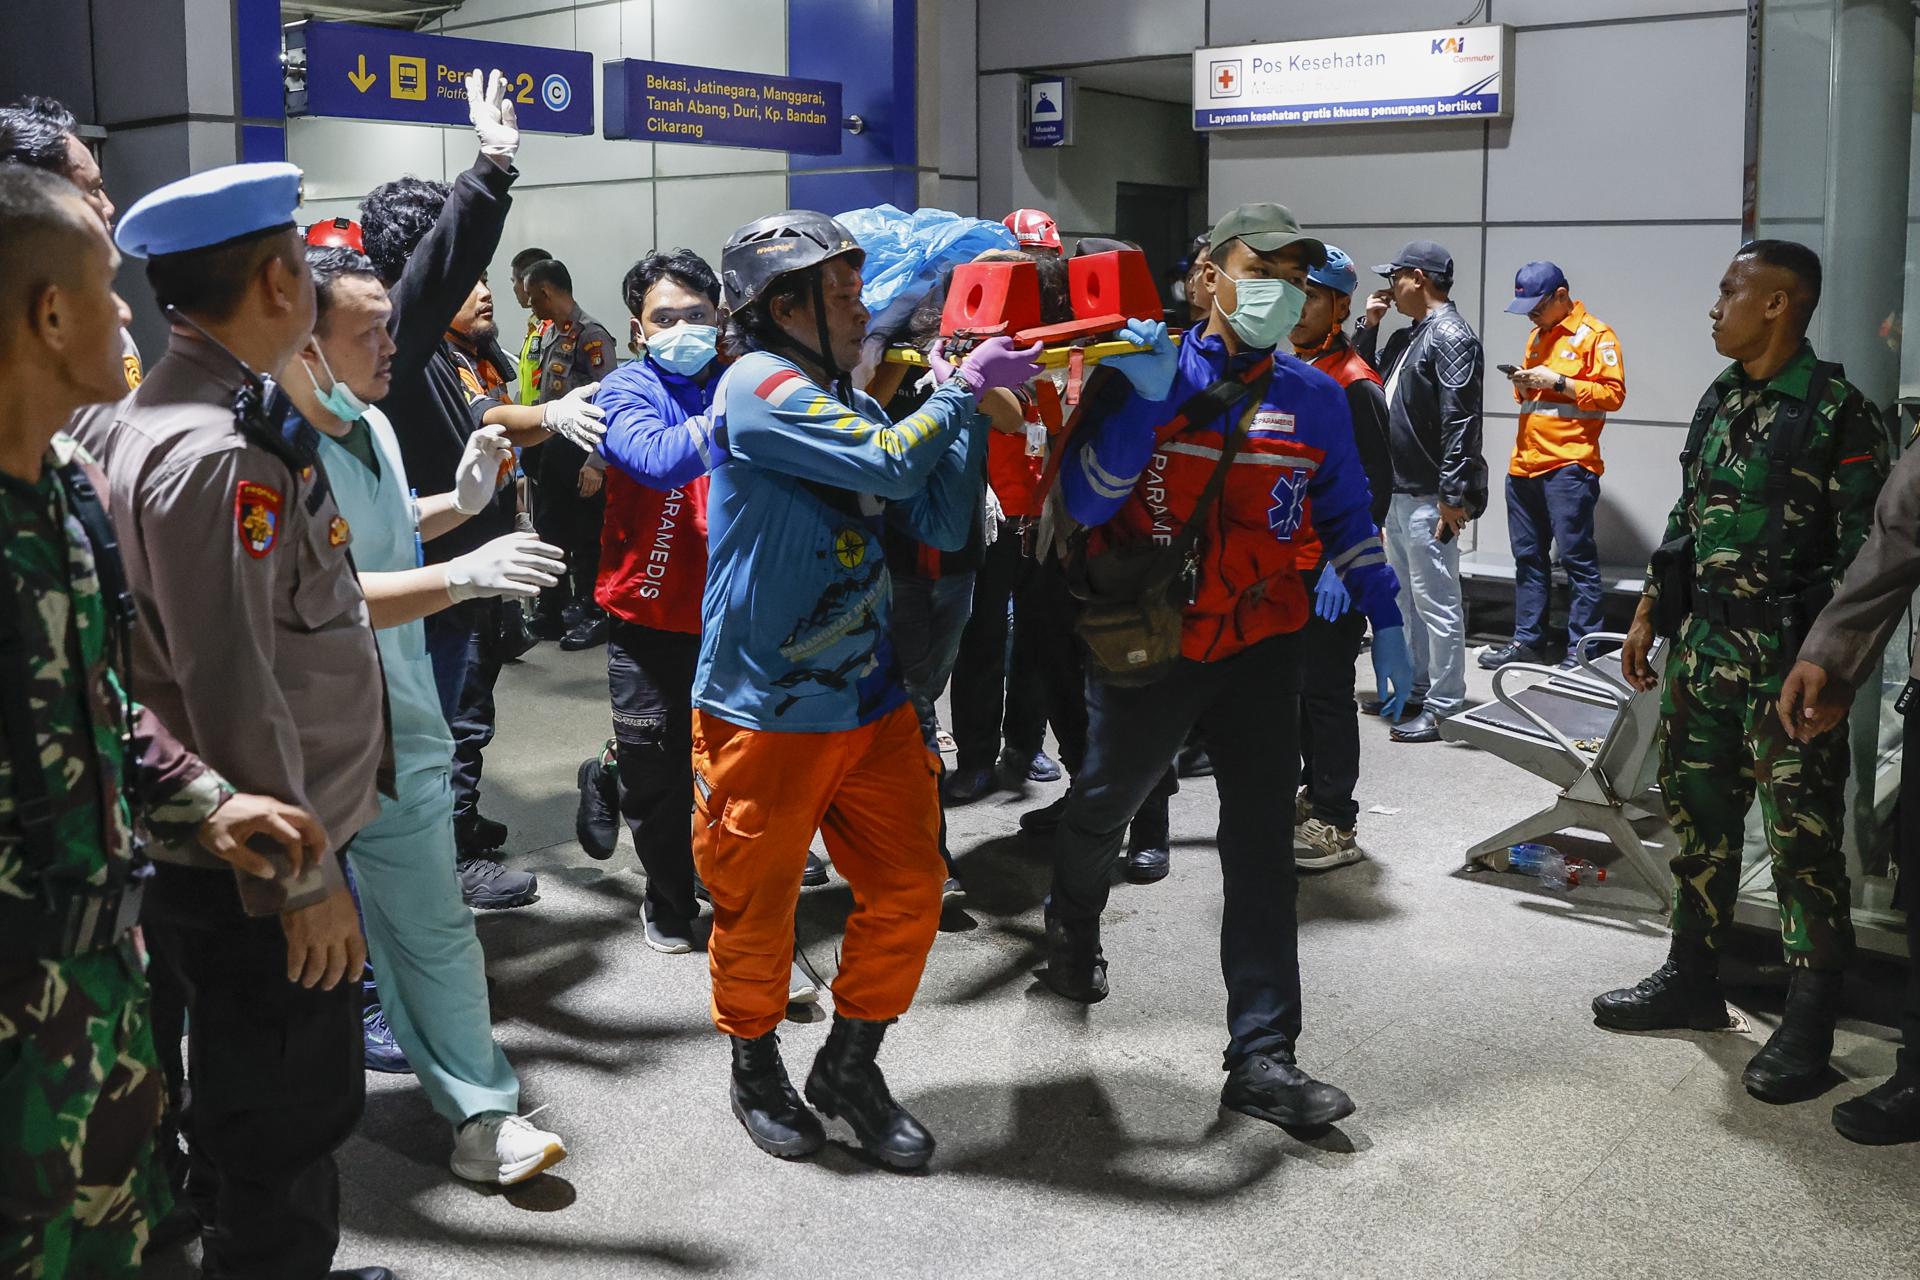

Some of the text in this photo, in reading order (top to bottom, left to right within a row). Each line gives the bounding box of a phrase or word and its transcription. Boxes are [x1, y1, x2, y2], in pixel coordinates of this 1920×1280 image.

[1252, 51, 1387, 74] Pos Kesehatan
[1452, 54, 1495, 64] Commuter
[437, 64, 474, 83] Per
[436, 86, 468, 99] Platfo
[551, 86, 562, 99] C
[646, 74, 826, 105] Bekasi, Jatinegara, Manggarai,
[646, 96, 827, 124] Tanah Abang, Duri, Kp. Bandan
[1209, 99, 1482, 126] Layanan kesehatan gratis khusus penumpang bertiket
[646, 117, 704, 138] Cikarang
[1146, 453, 1172, 547] PARAME
[640, 484, 685, 599] ARAMEDIS
